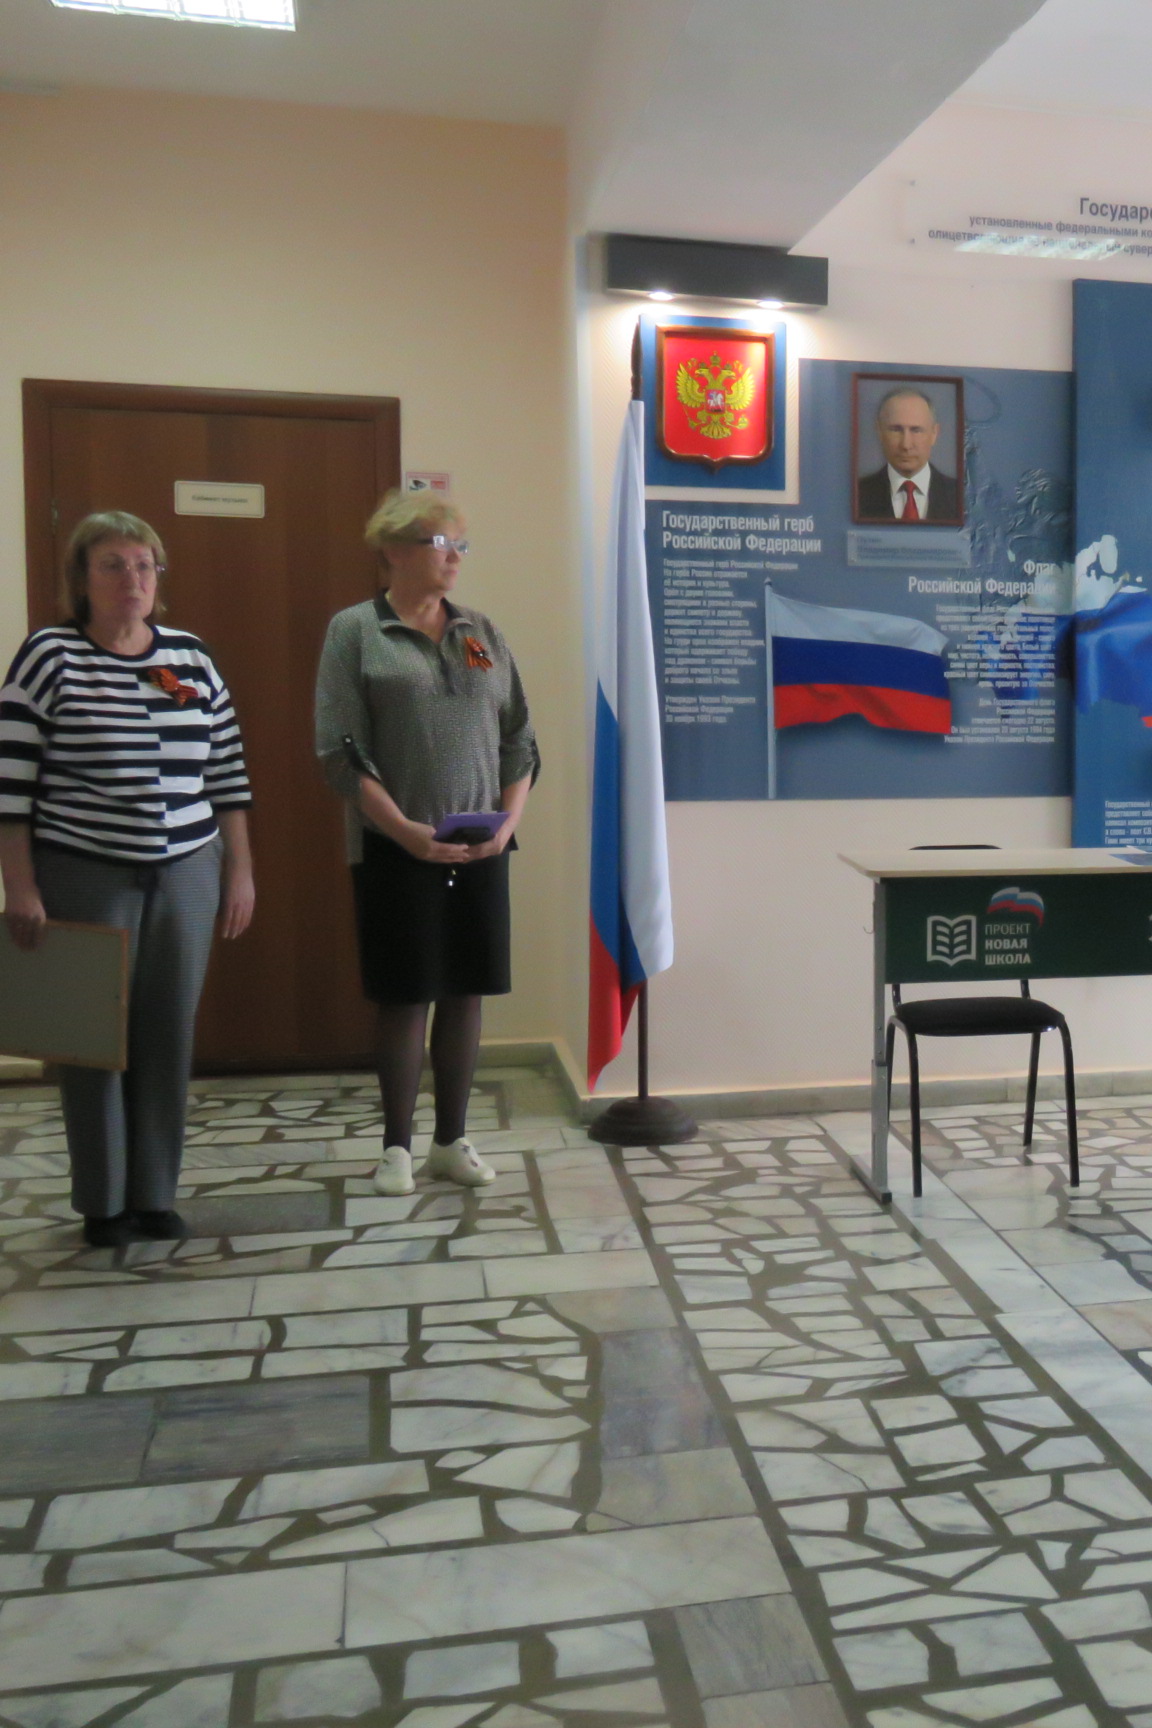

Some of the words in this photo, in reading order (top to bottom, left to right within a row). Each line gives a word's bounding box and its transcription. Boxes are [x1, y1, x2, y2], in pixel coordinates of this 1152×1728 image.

[968, 215, 1053, 231] установленные
[1055, 220, 1138, 238] федеральными
[662, 510, 780, 532] Государственный
[784, 515, 814, 535] герб
[663, 531, 742, 550] Российской
[745, 533, 822, 555] Федерации
[1023, 559, 1055, 575] Флаг
[908, 576, 982, 594] Российской
[984, 923, 1031, 936] ПРОЕКТ
[985, 937, 1028, 950] НОВАЯ
[984, 952, 1032, 966] ШКОЛА
